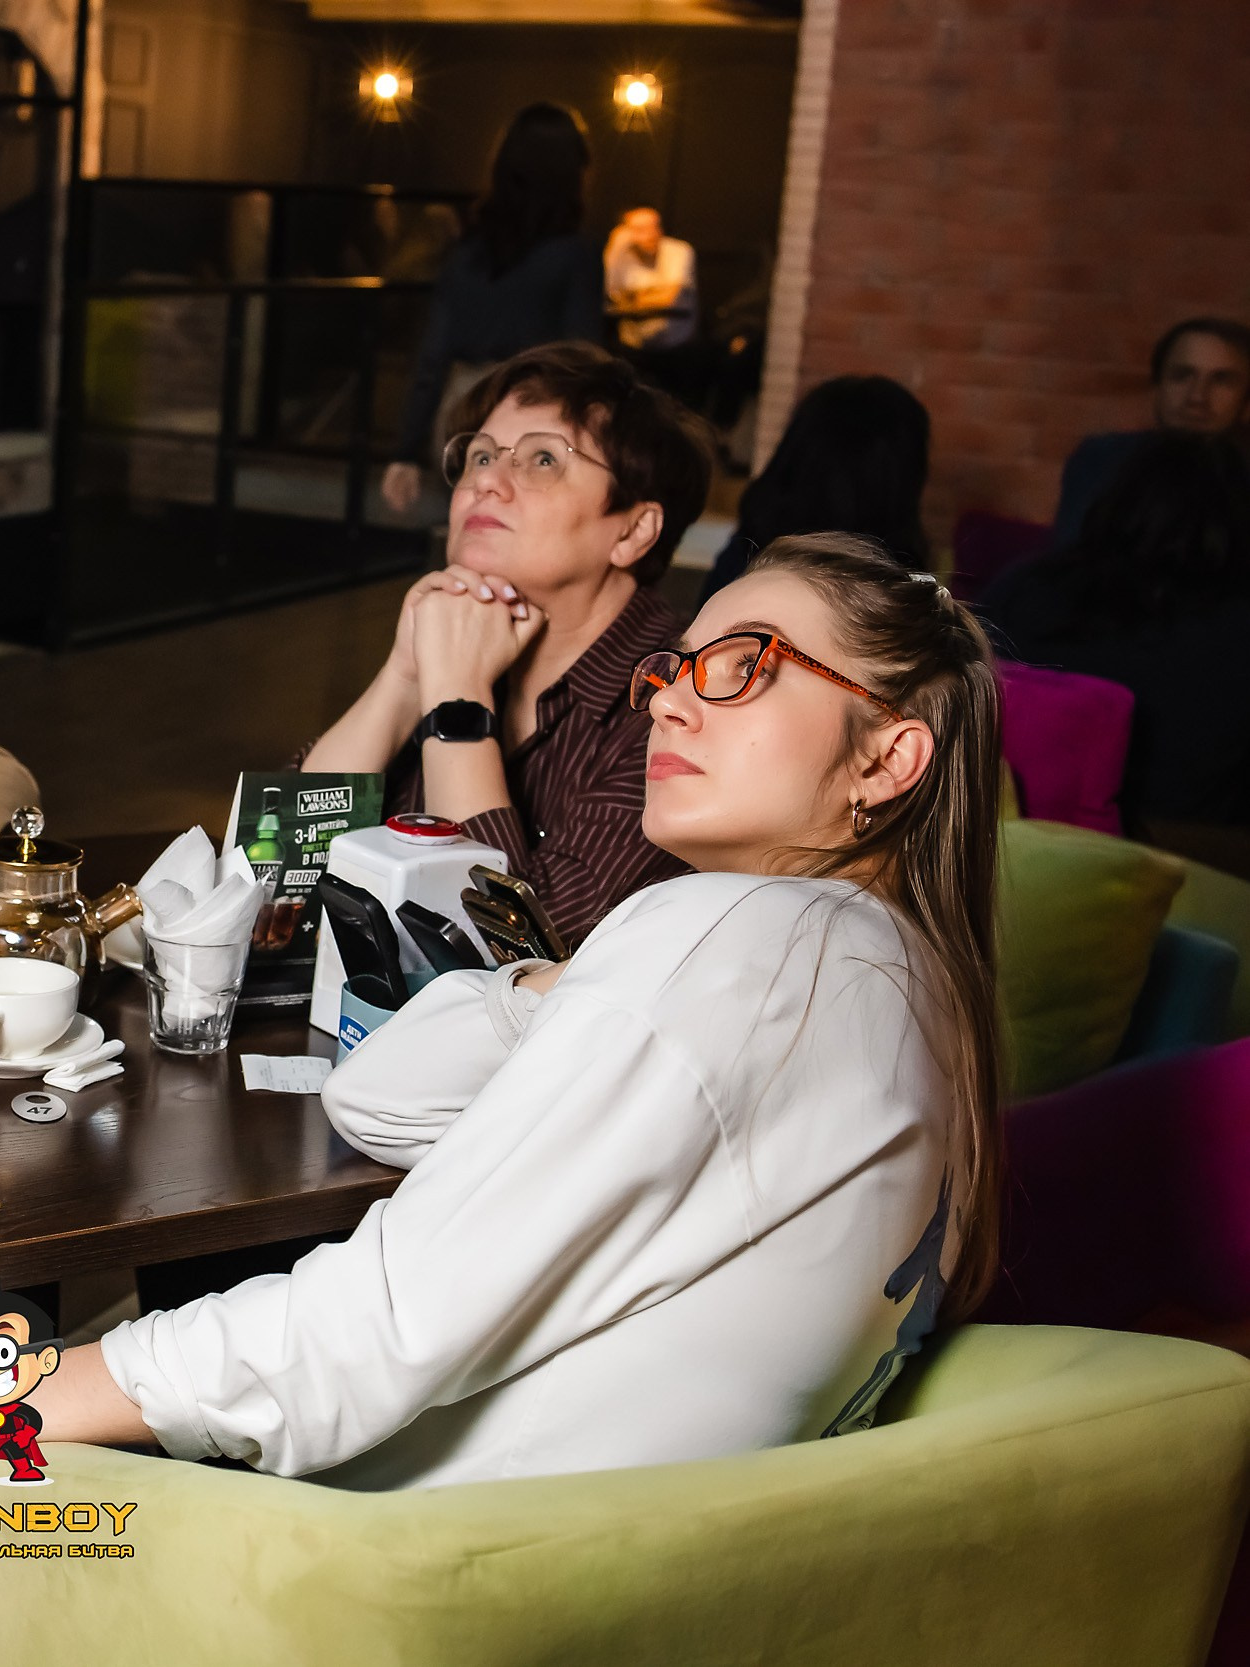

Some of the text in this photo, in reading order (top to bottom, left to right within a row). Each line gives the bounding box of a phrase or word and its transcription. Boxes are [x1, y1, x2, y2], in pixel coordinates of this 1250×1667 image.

[302, 790, 345, 803] WILLIAM
[300, 799, 348, 813] LAWSON'S
[294, 824, 317, 844] 3-Й
[286, 872, 318, 884] 3000
[26, 1106, 53, 1115] 47
